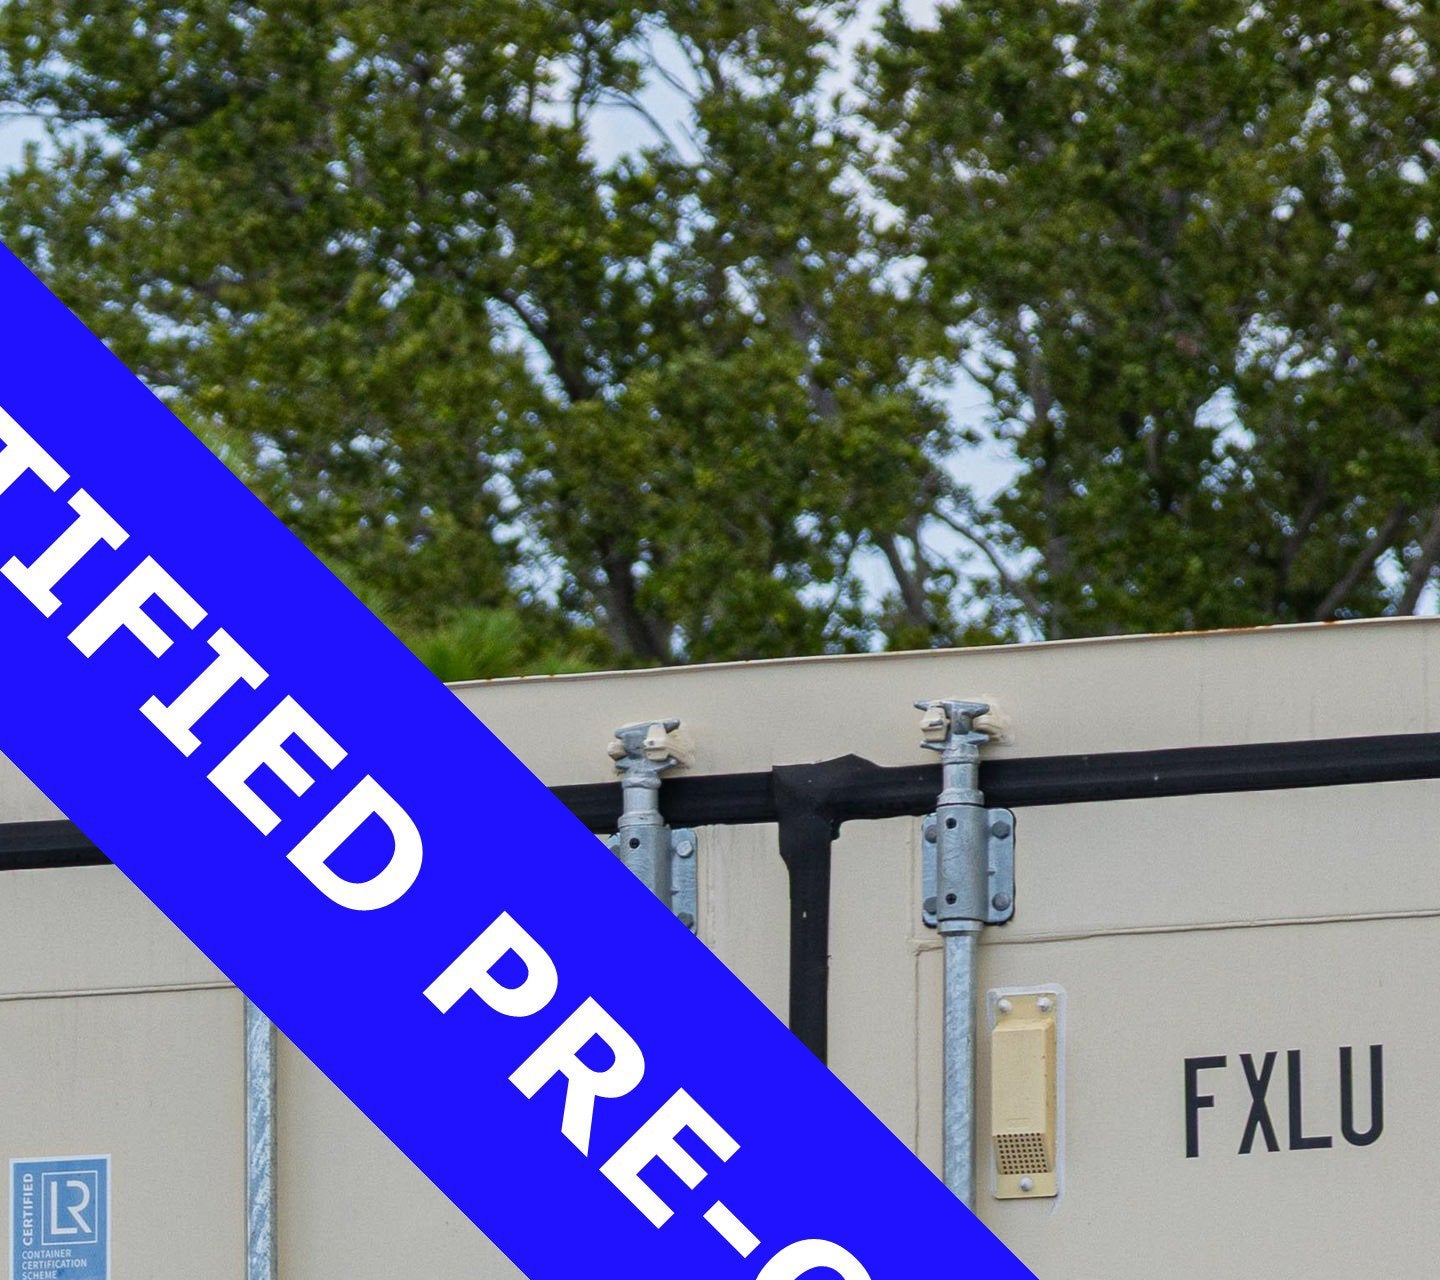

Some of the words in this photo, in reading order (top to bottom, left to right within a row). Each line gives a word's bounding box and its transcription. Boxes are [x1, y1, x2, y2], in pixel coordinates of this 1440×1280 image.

[1185, 1045, 1384, 1159] FXLU
[22, 1173, 34, 1246] CERTIFIED
[50, 1180, 93, 1235] LR
[21, 1249, 73, 1260] CONTAINER
[21, 1258, 87, 1271] CERTIFICATION
[21, 1270, 57, 1280] SCHEME
